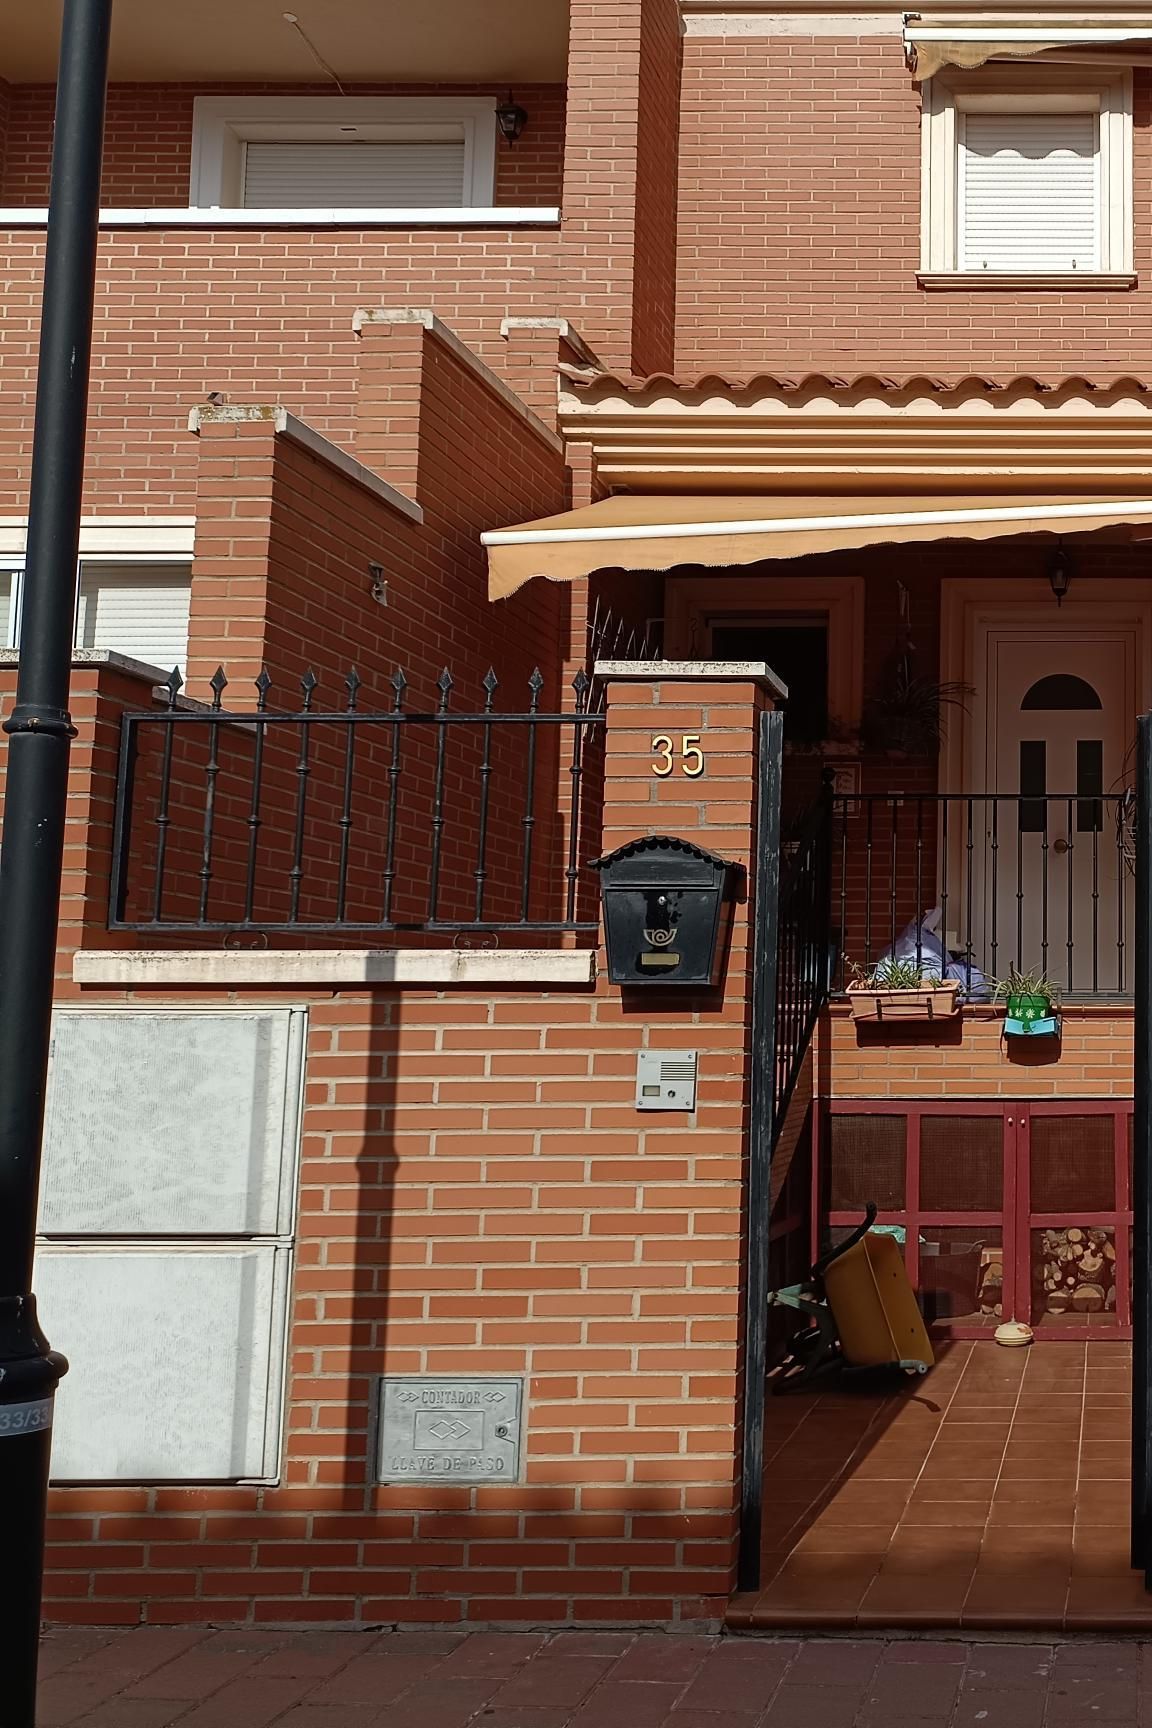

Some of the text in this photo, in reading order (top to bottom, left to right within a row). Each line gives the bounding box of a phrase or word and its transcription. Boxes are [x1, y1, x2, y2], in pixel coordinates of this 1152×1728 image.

[651, 735, 704, 776] 35
[421, 1391, 481, 1404] CONTADOR
[391, 1456, 504, 1471] LLAVE DE PASO
